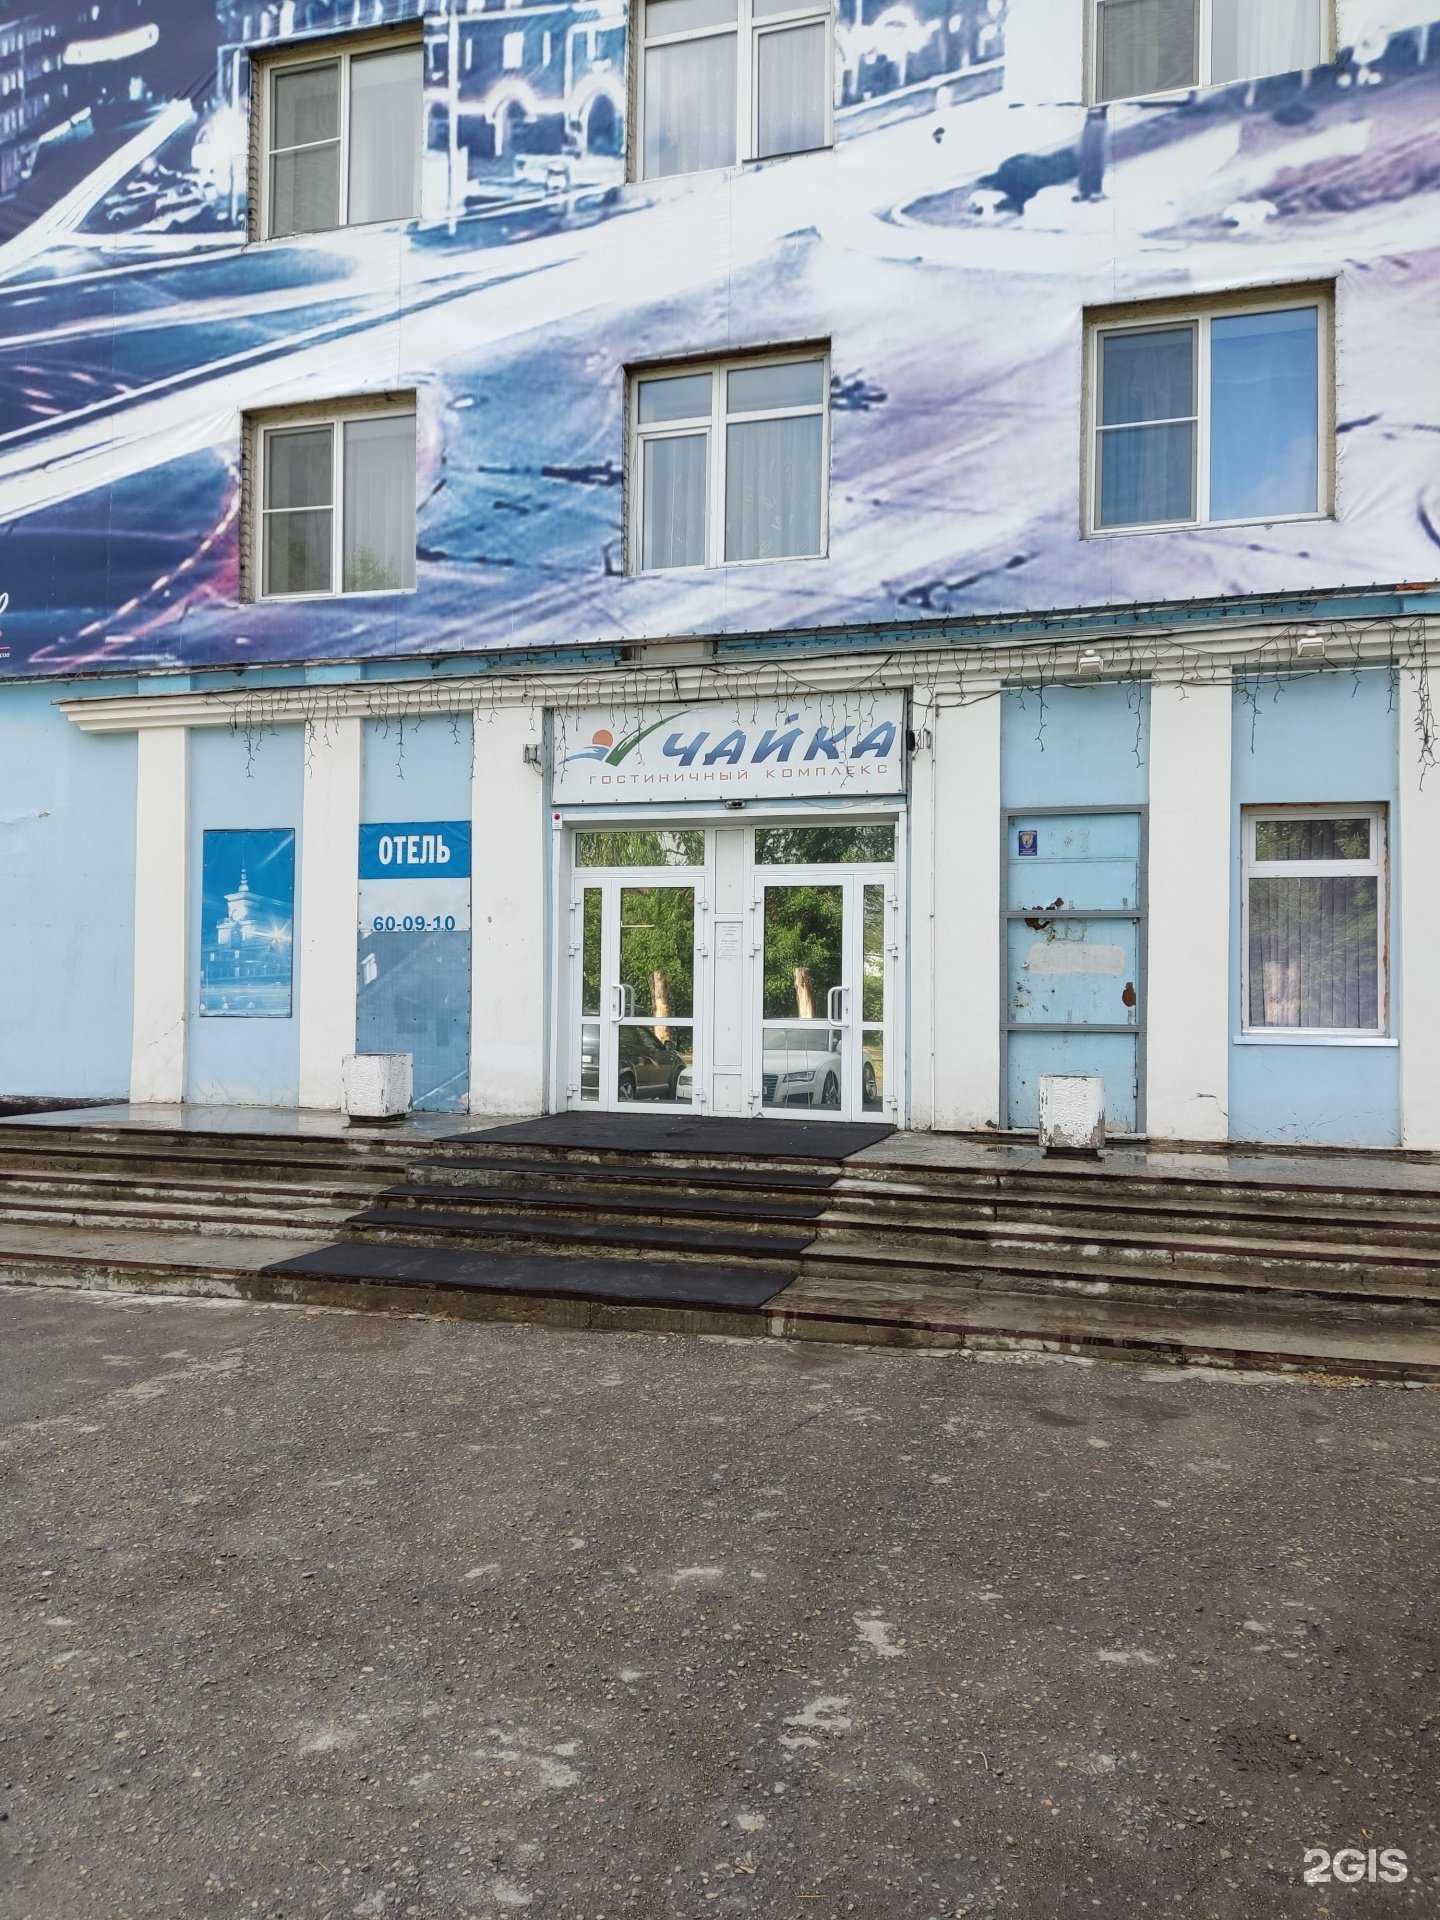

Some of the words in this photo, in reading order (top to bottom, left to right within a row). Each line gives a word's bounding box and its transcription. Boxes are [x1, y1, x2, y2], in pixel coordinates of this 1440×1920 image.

[662, 713, 896, 767] ЧАЙКА
[589, 769, 748, 785] ГОСТИНИЧНЫЙ
[766, 764, 888, 779] КОМПЛЕКС
[378, 835, 451, 865] ОТЕЛЬ
[373, 915, 456, 931] 60-09-10
